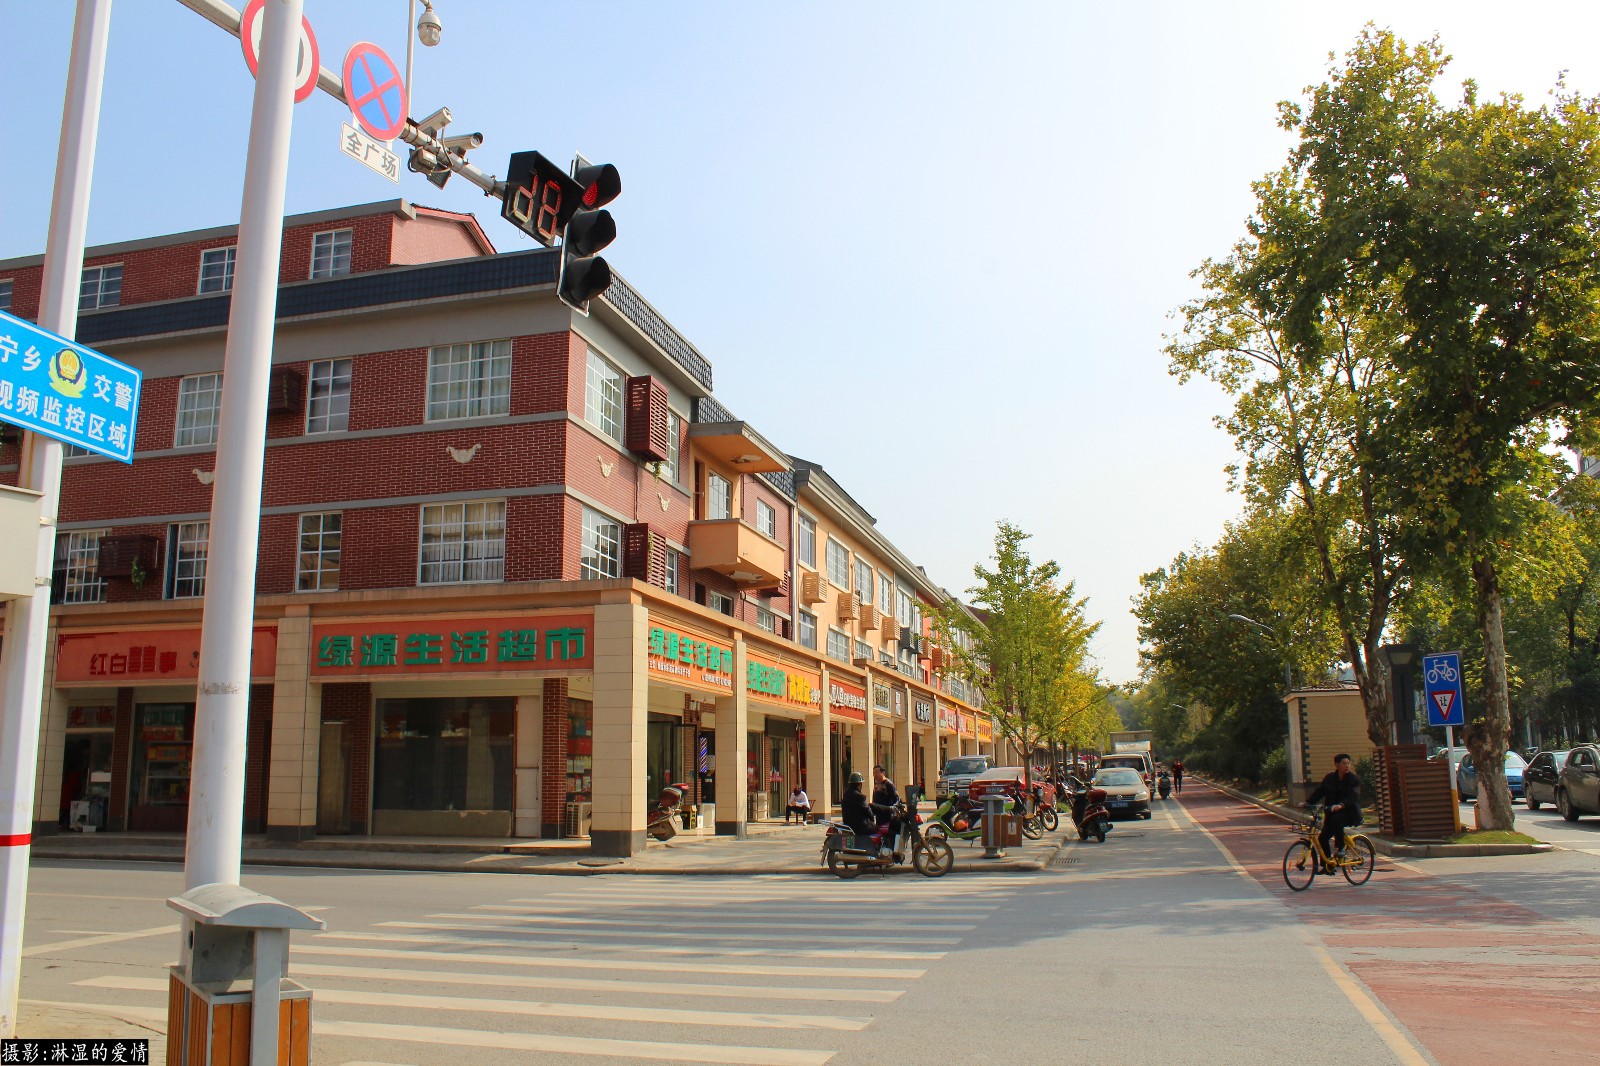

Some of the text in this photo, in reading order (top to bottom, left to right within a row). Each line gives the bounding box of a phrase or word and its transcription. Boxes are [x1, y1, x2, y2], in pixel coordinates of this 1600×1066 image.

[347, 132, 396, 178] 全广场
[0, 335, 133, 411] 宁乡 交警
[317, 627, 586, 667] 绿源生活超市
[1440, 696, 1448, 707] 让
